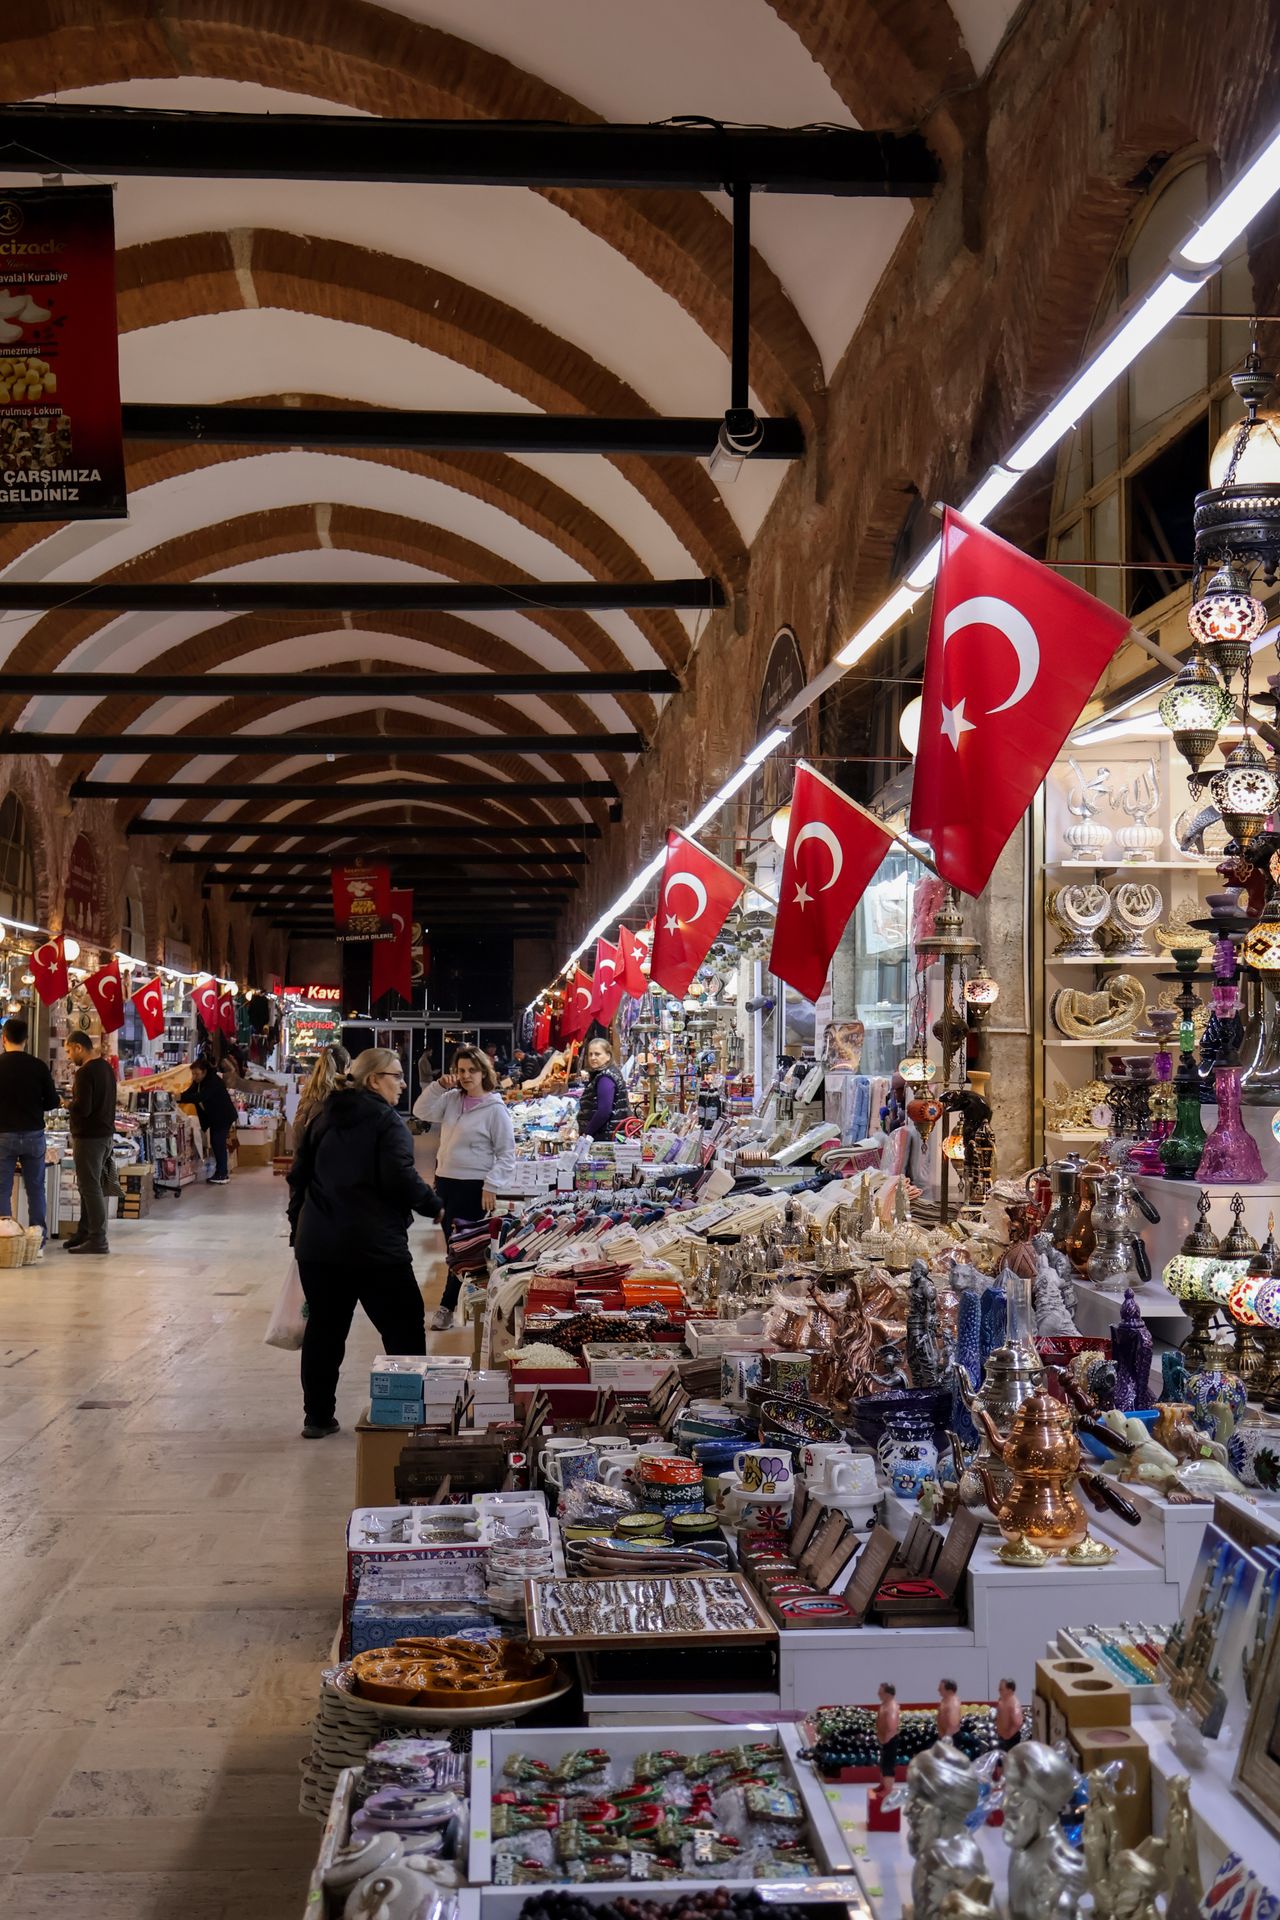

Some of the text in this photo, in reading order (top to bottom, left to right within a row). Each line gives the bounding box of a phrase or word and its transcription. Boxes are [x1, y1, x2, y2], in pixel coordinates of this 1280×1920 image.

[28, 272, 68, 283] Kurabiye
[33, 407, 63, 416] Lokum
[3, 469, 101, 487] ÇARŞIMIZA
[0, 485, 79, 502] GELDİNİZ
